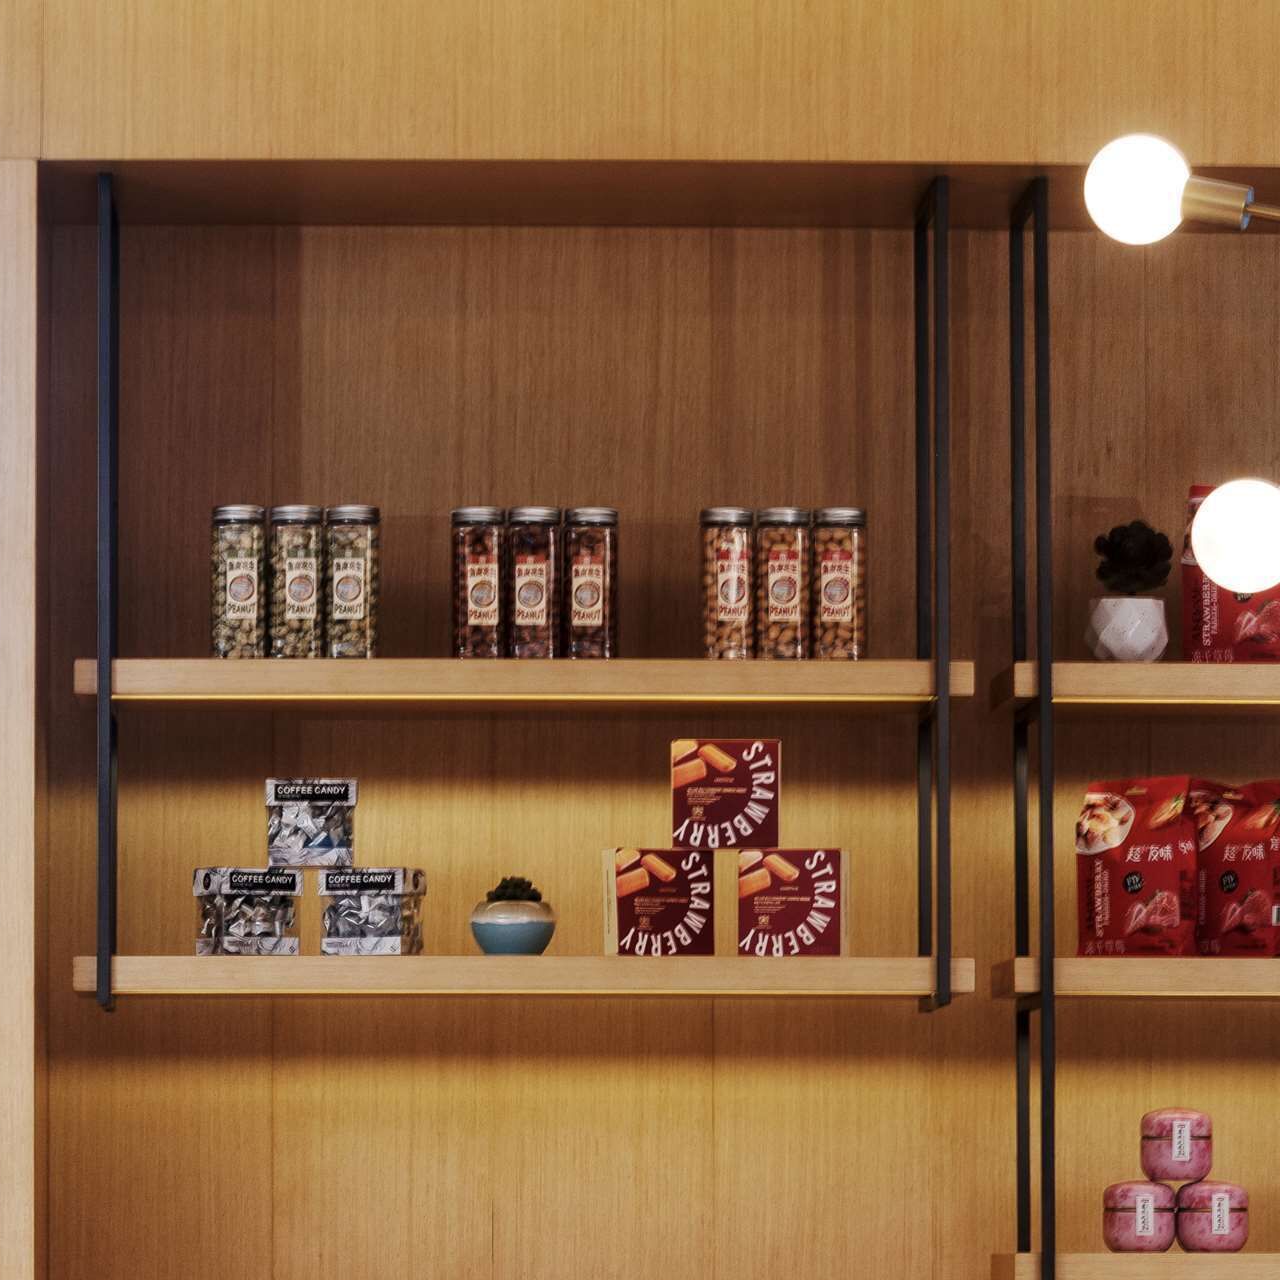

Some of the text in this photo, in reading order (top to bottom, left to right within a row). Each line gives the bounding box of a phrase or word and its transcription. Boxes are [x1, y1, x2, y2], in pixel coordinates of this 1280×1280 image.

[228, 602, 255, 614] PEANUT
[287, 602, 315, 614] PEANUT
[335, 602, 362, 614] PEANUT
[719, 605, 746, 617] PEANUT
[770, 605, 798, 617] PEANUT
[822, 605, 850, 617] PEANUT
[469, 609, 496, 621] PEANUT
[517, 609, 544, 621] PEANUT
[573, 609, 601, 621] PEANUT
[277, 785, 345, 795] COFFEE CANDY
[671, 741, 775, 849] STRAWBERRY
[232, 874, 293, 884] COFFEE CANDY
[328, 874, 392, 884] COFFEE CANDY
[619, 852, 711, 957] STRAWBERRY
[739, 851, 837, 957] STRAWBERRY
